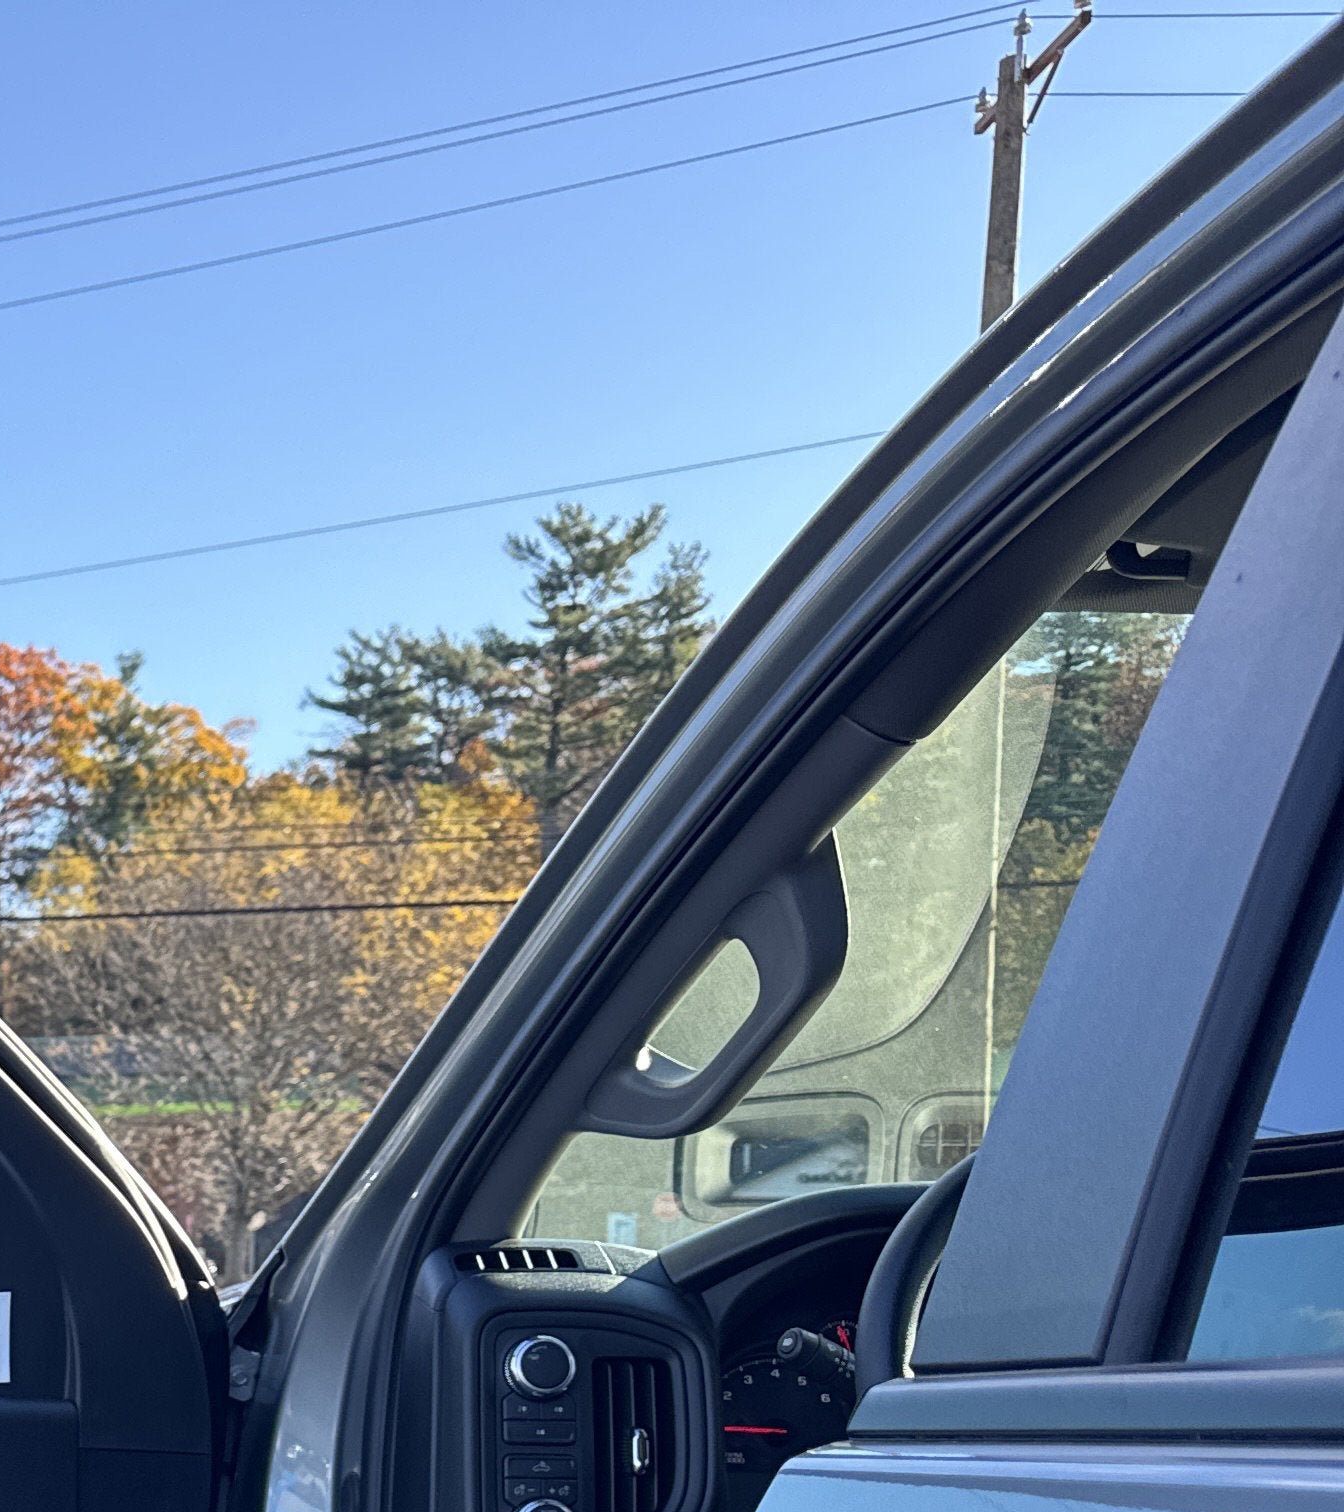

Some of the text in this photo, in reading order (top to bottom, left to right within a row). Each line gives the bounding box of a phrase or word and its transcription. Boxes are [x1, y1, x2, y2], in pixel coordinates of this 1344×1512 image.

[770, 1369, 780, 1378] 4
[743, 1375, 753, 1385] 3
[797, 1376, 807, 1386] 5
[723, 1391, 732, 1400] 2
[820, 1393, 831, 1403] 6
